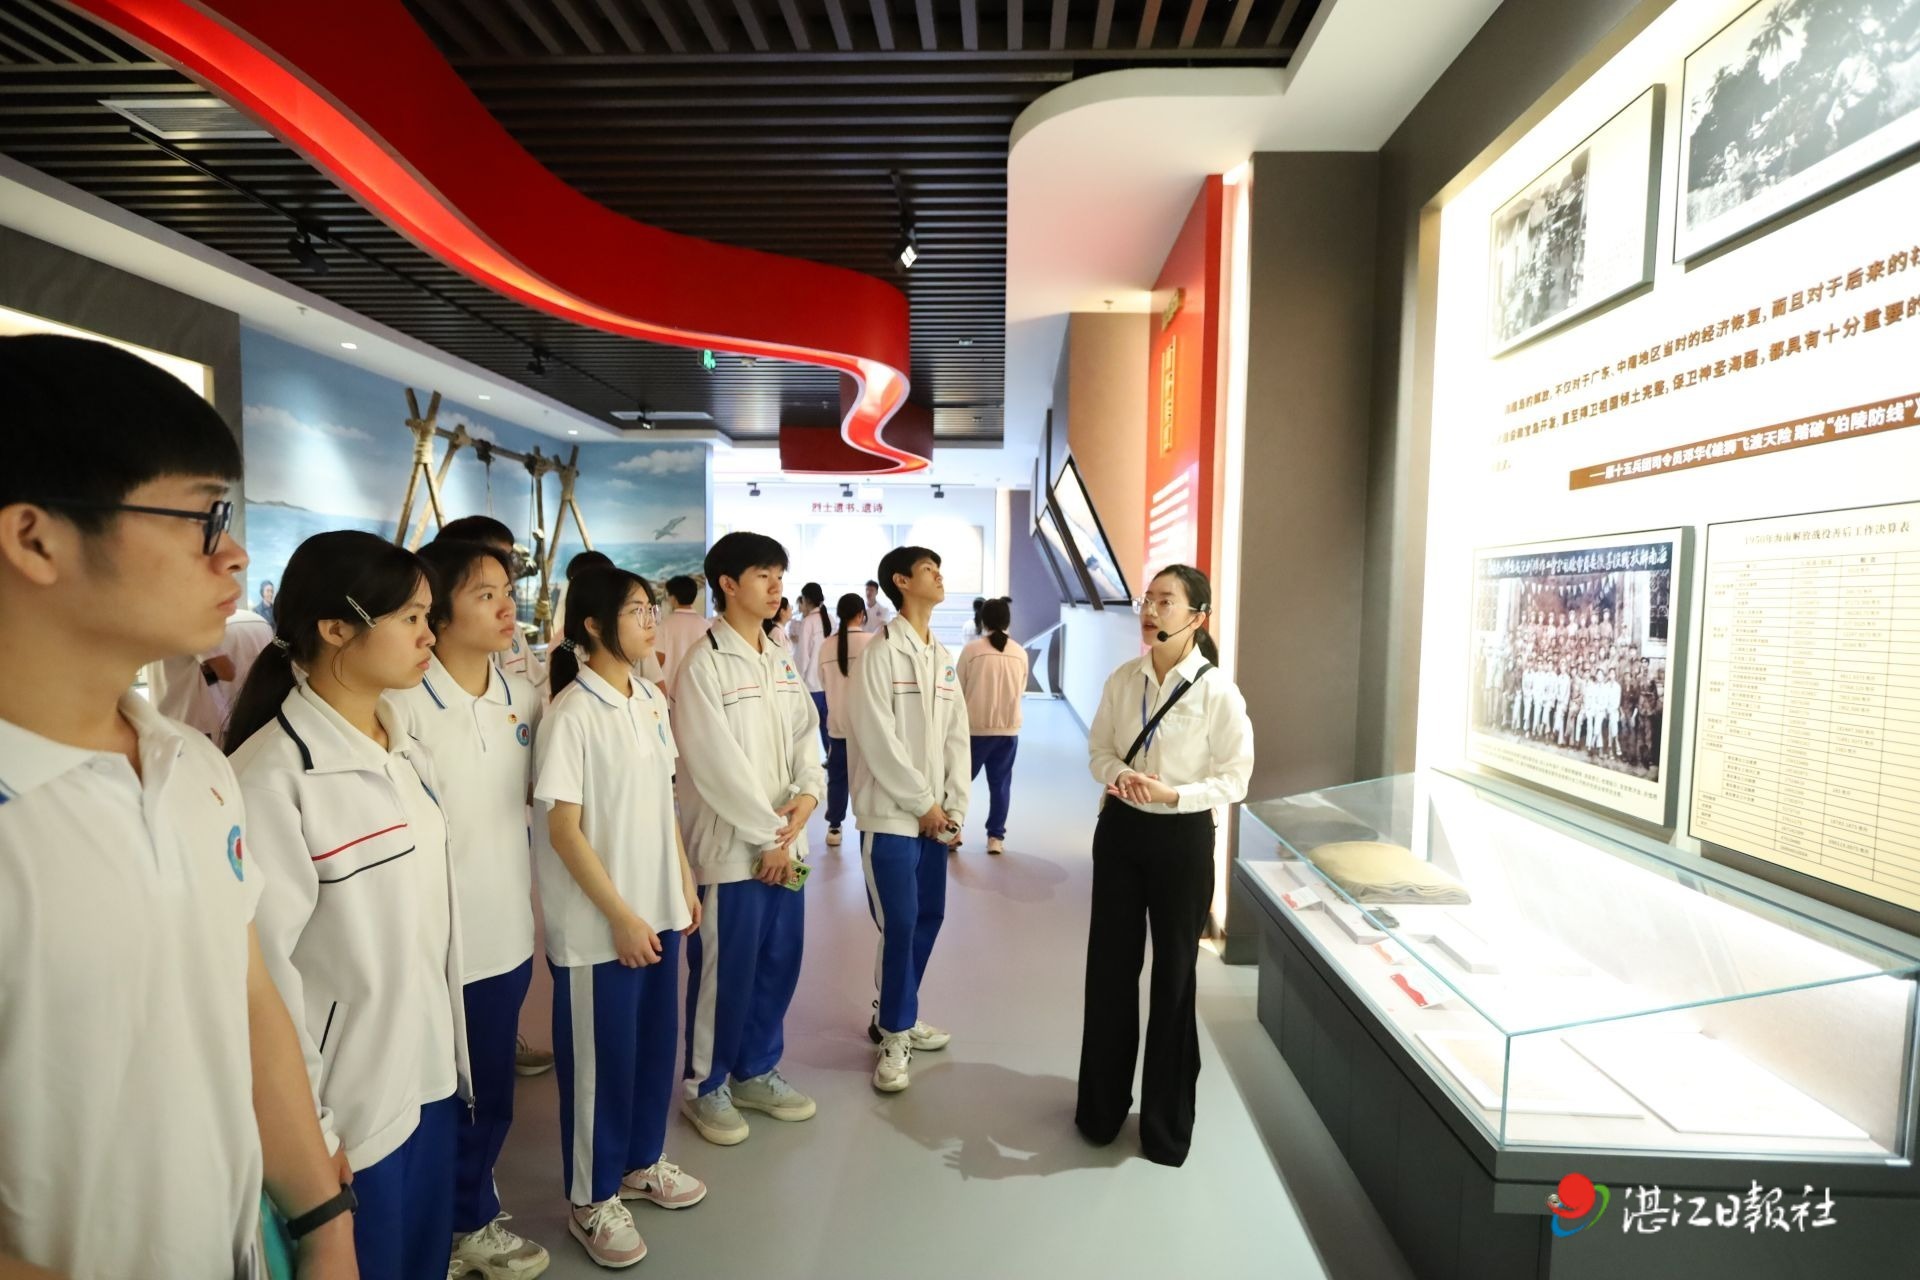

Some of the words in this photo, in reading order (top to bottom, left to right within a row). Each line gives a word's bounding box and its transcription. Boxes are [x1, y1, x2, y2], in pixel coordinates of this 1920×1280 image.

[811, 502, 883, 513] 烈士遗书、遗诗
